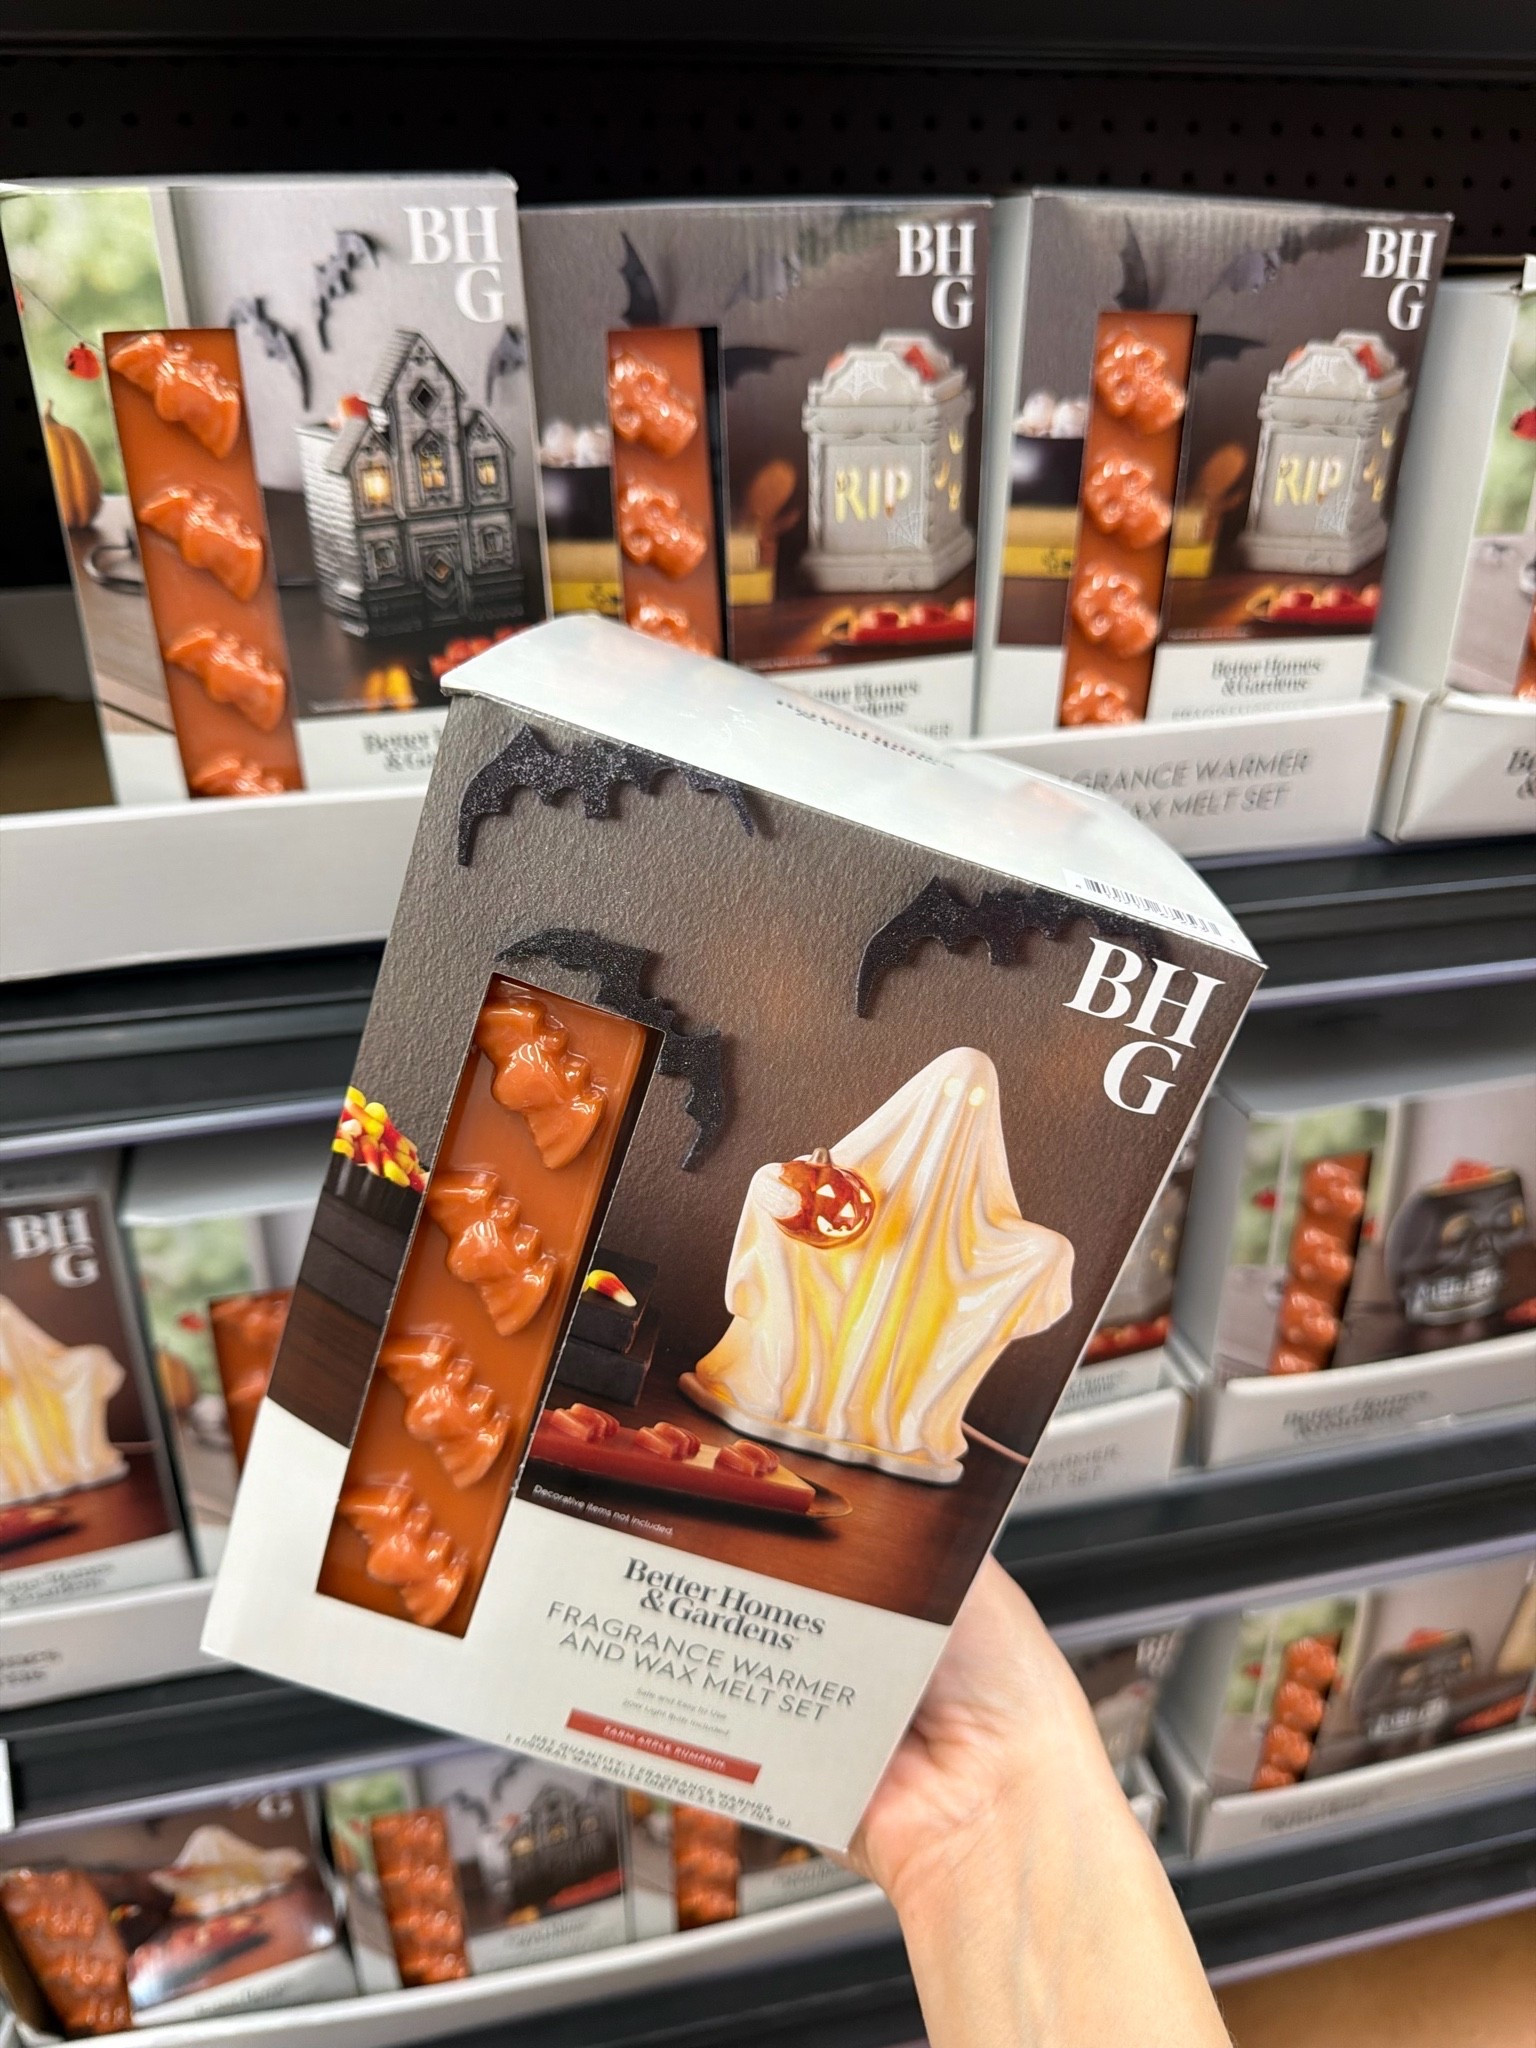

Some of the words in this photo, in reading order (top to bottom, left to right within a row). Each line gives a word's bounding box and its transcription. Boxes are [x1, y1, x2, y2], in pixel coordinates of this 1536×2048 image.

[402, 206, 502, 264] BH
[896, 221, 976, 276] BH
[1361, 227, 1437, 281] BH
[455, 266, 504, 323] G
[931, 277, 974, 329] G
[1388, 281, 1426, 331] G
[835, 467, 911, 523] RIP
[1274, 455, 1342, 507] RIP
[1058, 759, 1188, 794] GRANCE
[1196, 747, 1312, 782] WARMER
[1121, 797, 1166, 821] AX
[1169, 785, 1241, 819] MELT
[1241, 780, 1291, 813] SET
[1062, 937, 1227, 1048] BH
[1103, 1041, 1182, 1115] G
[7, 1207, 95, 1260] BH
[50, 1245, 99, 1288] G
[531, 1484, 586, 1511] Decorative
[585, 1502, 612, 1520] items
[612, 1511, 630, 1525] not
[624, 1557, 718, 1602] Better
[718, 1585, 826, 1636] Homes
[639, 1588, 664, 1613] &
[668, 1595, 798, 1651] Gardens
[547, 1600, 725, 1668] FRAGRANCE
[732, 1654, 857, 1708] WARMER
[559, 1631, 626, 1663] AND
[632, 1651, 699, 1686] WAX
[702, 1672, 776, 1708] MELT
[777, 1694, 830, 1722] SET
[603, 1724, 636, 1743] FARM
[673, 1746, 727, 1773] PUMPKIN
